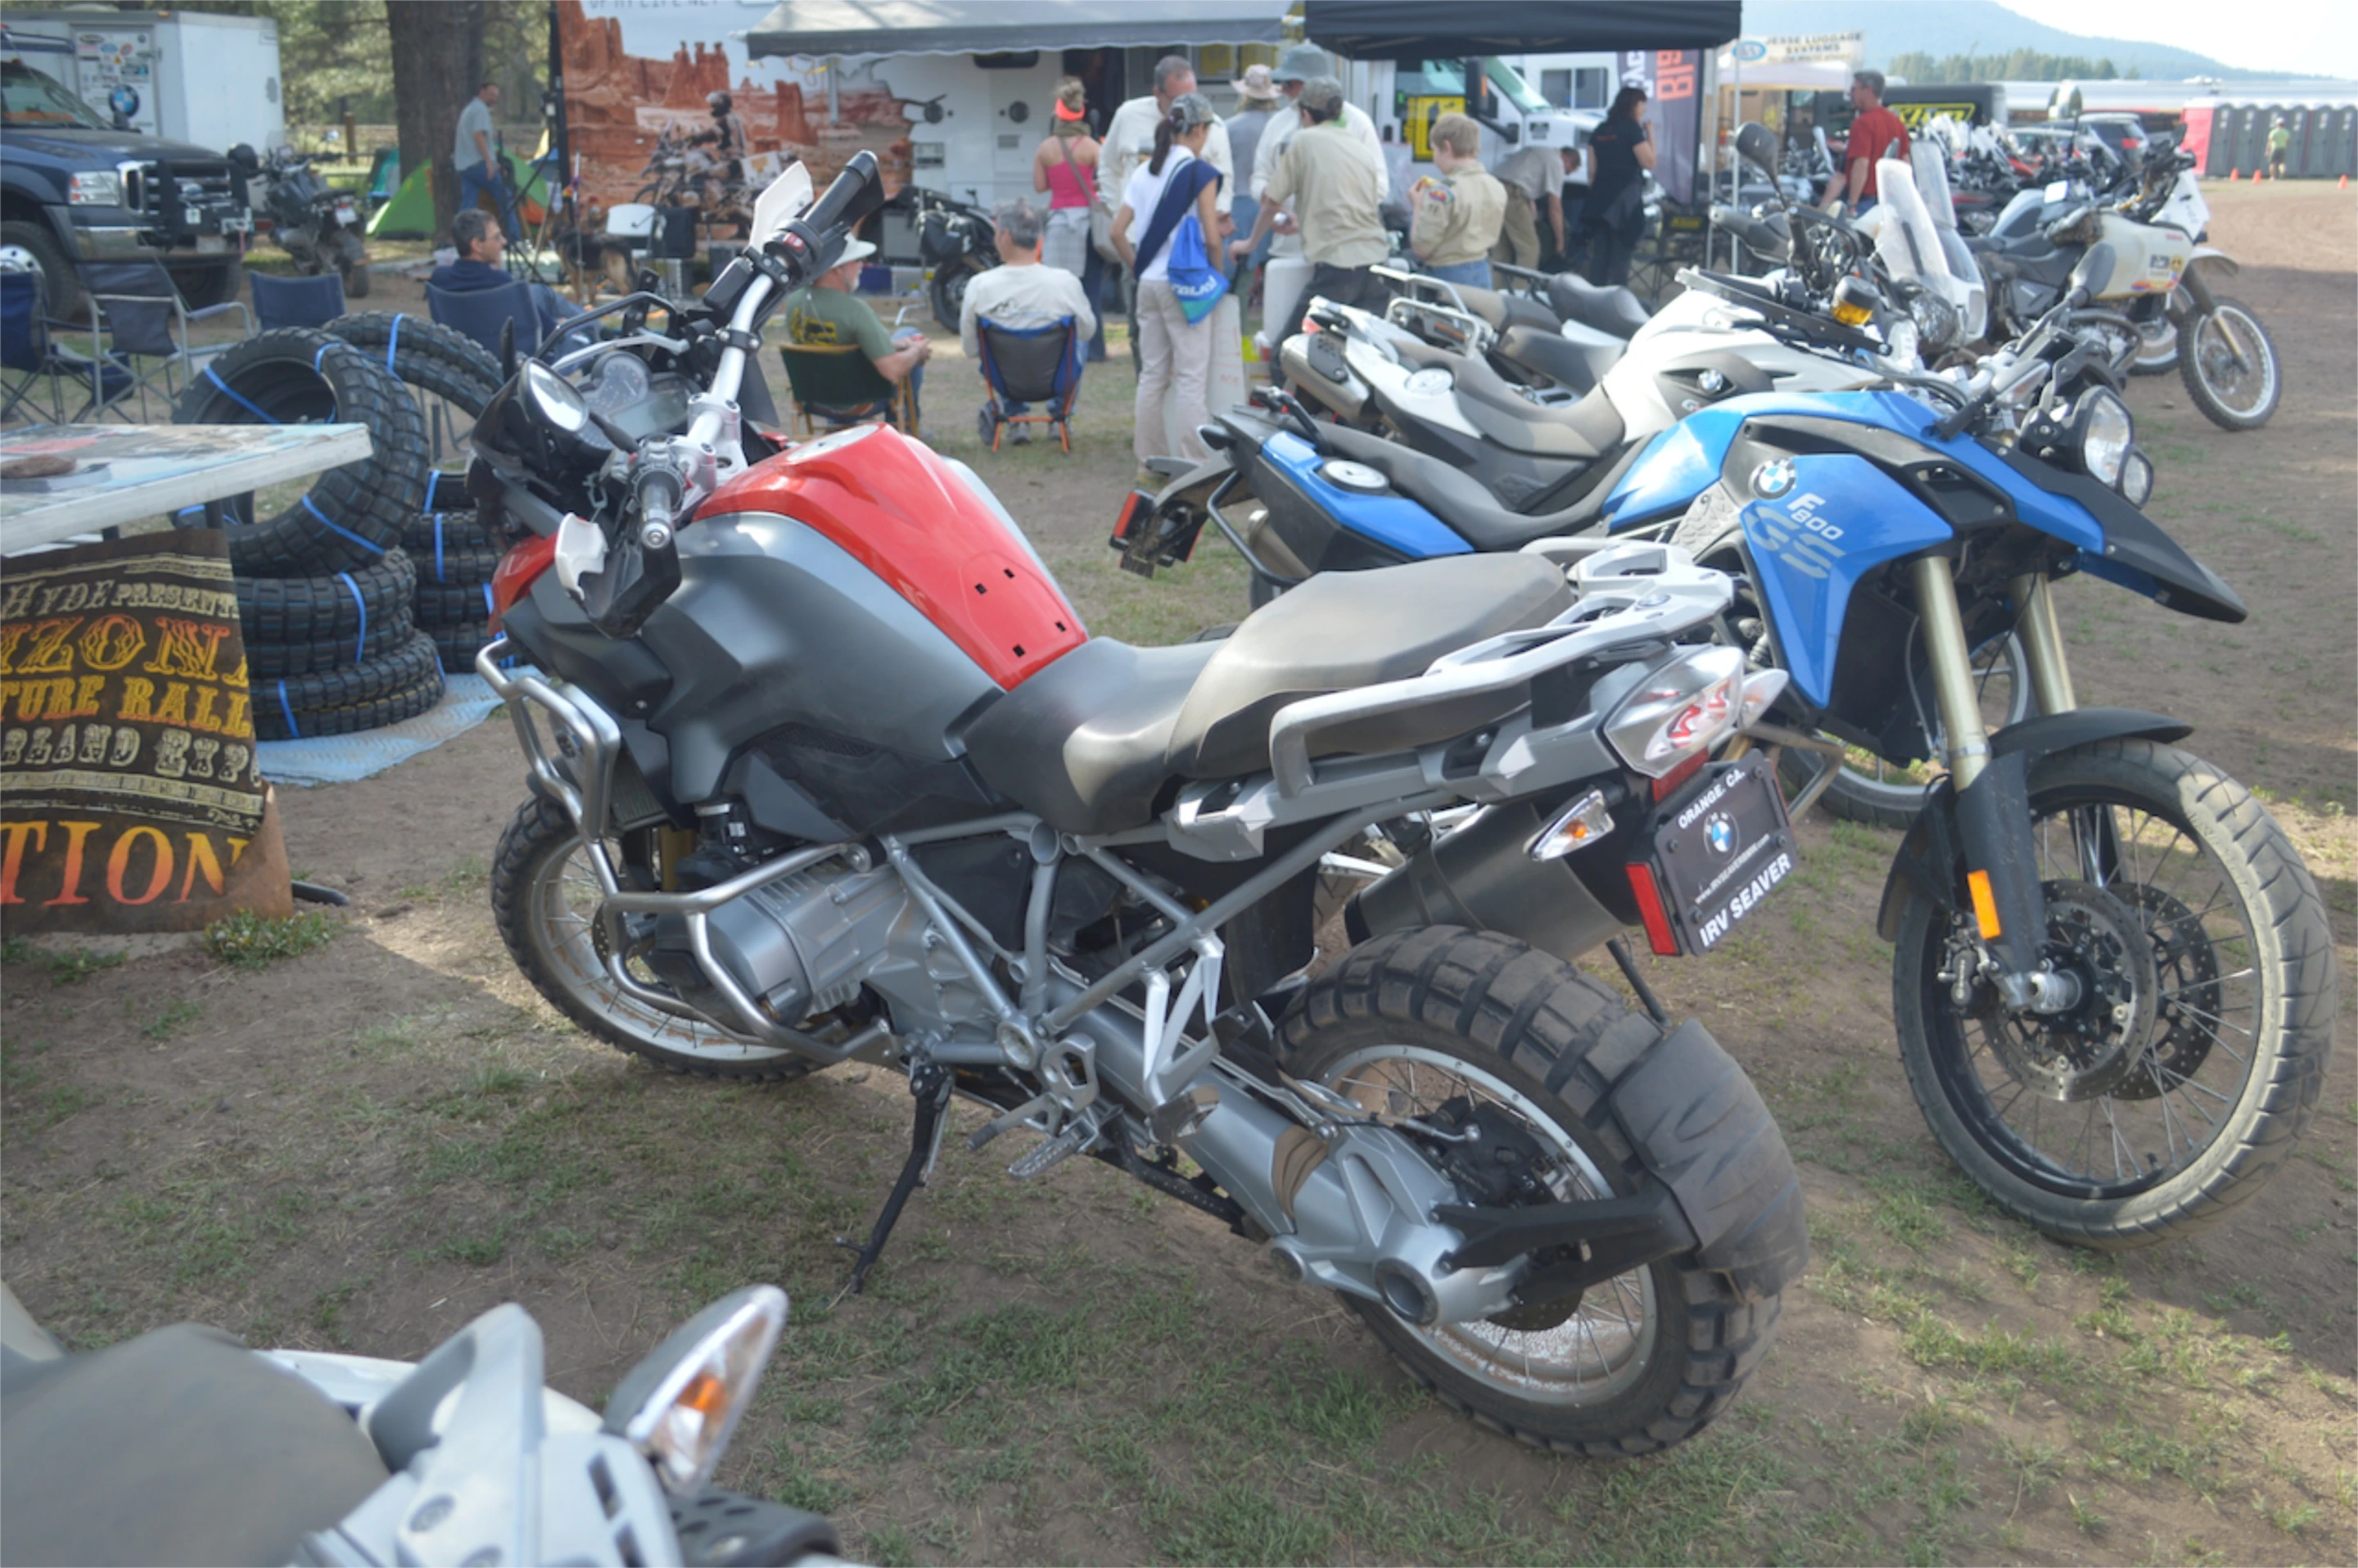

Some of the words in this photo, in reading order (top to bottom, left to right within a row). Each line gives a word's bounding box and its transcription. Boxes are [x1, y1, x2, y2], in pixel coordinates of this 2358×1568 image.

[1790, 508, 1845, 541] 800
[154, 727, 261, 788] EXP
[1699, 908, 1728, 948] IRV
[1728, 852, 1791, 920] SEAVER
